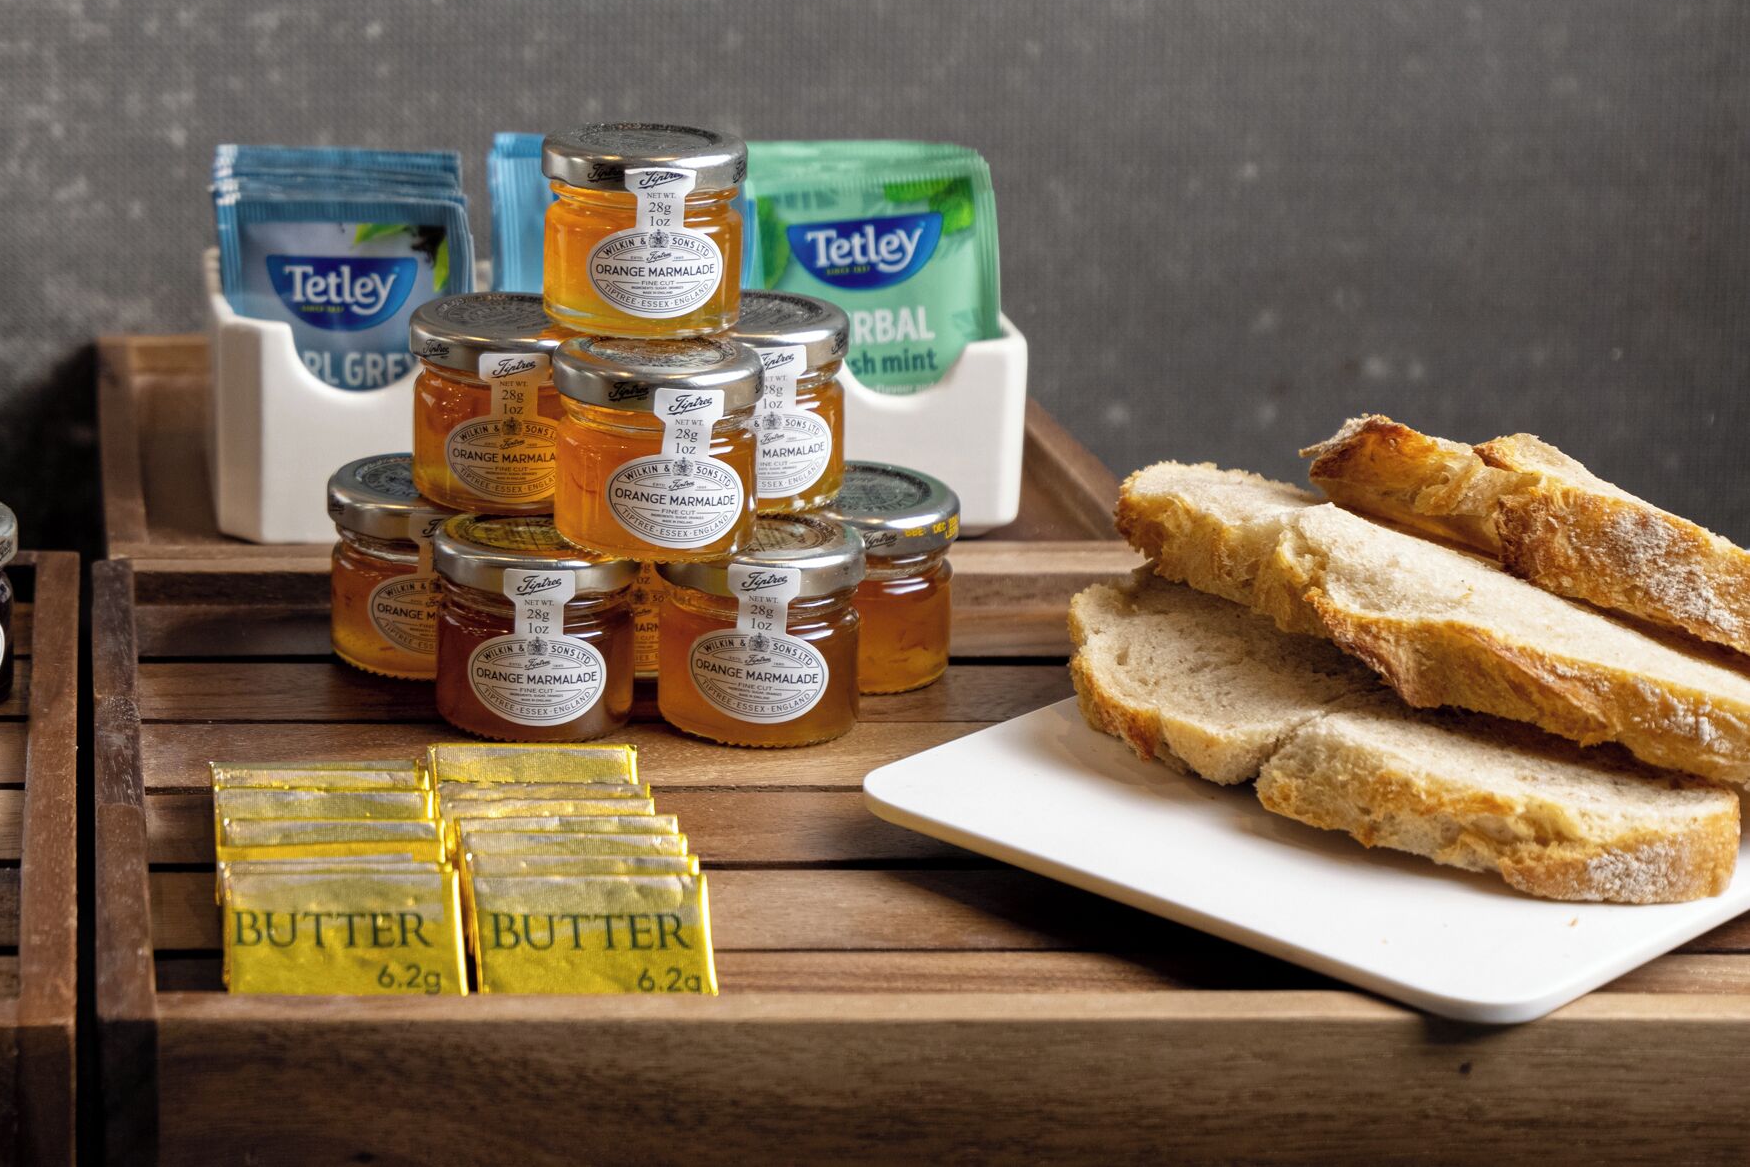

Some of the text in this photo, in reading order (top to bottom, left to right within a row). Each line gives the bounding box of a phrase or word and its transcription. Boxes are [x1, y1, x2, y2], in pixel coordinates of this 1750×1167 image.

[648, 202, 671, 215] 28g
[649, 216, 671, 227] 1oz
[602, 237, 710, 258] WILKIN & SONS LTD
[805, 225, 924, 273] Tetley
[595, 263, 715, 278] ORANGE MARMALADE
[283, 264, 398, 316] Tetley
[850, 306, 936, 345] RBAL
[303, 350, 340, 385] RL
[881, 347, 938, 373] mint
[667, 394, 713, 416] Tiptree
[675, 428, 698, 443] 28g
[452, 448, 499, 463] ORANGE
[675, 443, 696, 455] 1oz
[762, 441, 825, 459] MARMALADE
[624, 464, 731, 487] WILKIN & SONS LTD
[615, 487, 736, 507] ORANGE MARMALADE
[515, 575, 562, 596] Tiptree
[740, 571, 788, 592] Tiptree
[526, 608, 550, 622] 28g
[750, 604, 775, 619] 28g
[528, 622, 550, 634] 1oz
[751, 618, 772, 631] 1oz
[483, 644, 591, 664] WILKIN & SONS LTD
[704, 639, 814, 667] WILKIN & SONS LTD
[476, 668, 598, 685] ORANGE MARMALADE
[695, 658, 819, 684] ORANGE MARMALADE
[232, 909, 435, 949] BUTTER
[491, 912, 696, 951] BUTTER
[377, 964, 442, 995] 6.2g
